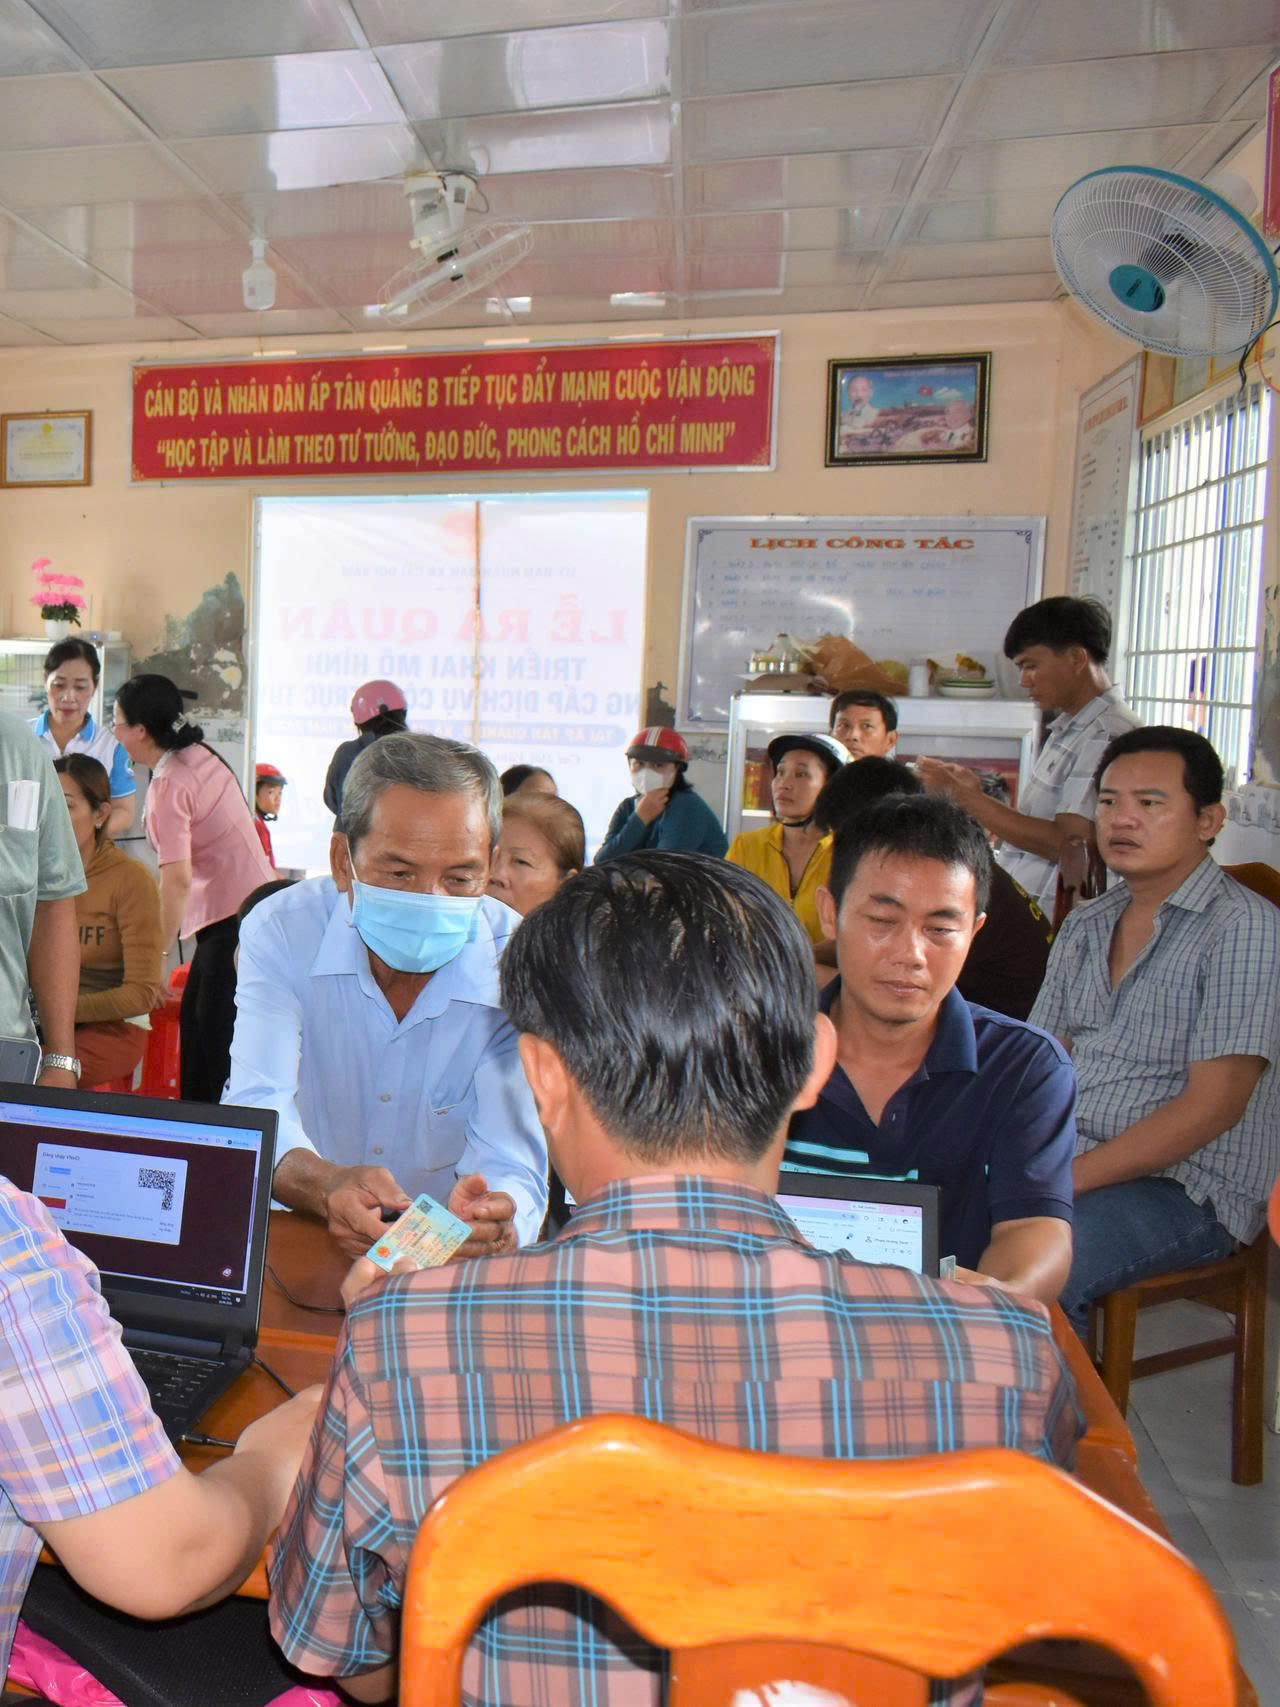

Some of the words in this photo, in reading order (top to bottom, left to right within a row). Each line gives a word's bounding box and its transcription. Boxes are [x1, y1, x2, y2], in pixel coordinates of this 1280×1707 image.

[144, 381, 173, 417] CÁN
[178, 379, 199, 422] BỘ
[203, 378, 223, 415] VÀ
[227, 377, 268, 414] NHÂN
[273, 375, 305, 413] DÂN
[308, 370, 331, 411] ẤP
[334, 373, 365, 411] TÂN
[369, 367, 423, 414] QUẢNG
[426, 377, 439, 408] B
[443, 363, 481, 406] TIẾP
[484, 374, 518, 411] TỤC
[521, 356, 556, 404] ĐẨY
[561, 370, 610, 408] MẠNH
[615, 360, 661, 405] CUỘC
[666, 358, 702, 404] VẬN
[706, 357, 756, 403] ĐỘNG
[200, 430, 229, 472] TẬP
[233, 429, 252, 465] VÀ
[257, 428, 290, 465] LÀM
[294, 433, 334, 464] THEO
[340, 428, 361, 463] TƯ
[364, 420, 420, 467] TƯỞNG,
[425, 429, 459, 466] ĐẠO
[463, 421, 501, 464] ĐỨC,
[507, 427, 562, 458] PHONG
[566, 417, 610, 457] CÁCH
[616, 410, 640, 455] HỒ
[646, 415, 675, 455] CHÍ
[750, 537, 817, 551] LỊCH
[825, 535, 906, 549] CÔNG
[913, 535, 975, 549] TÁC
